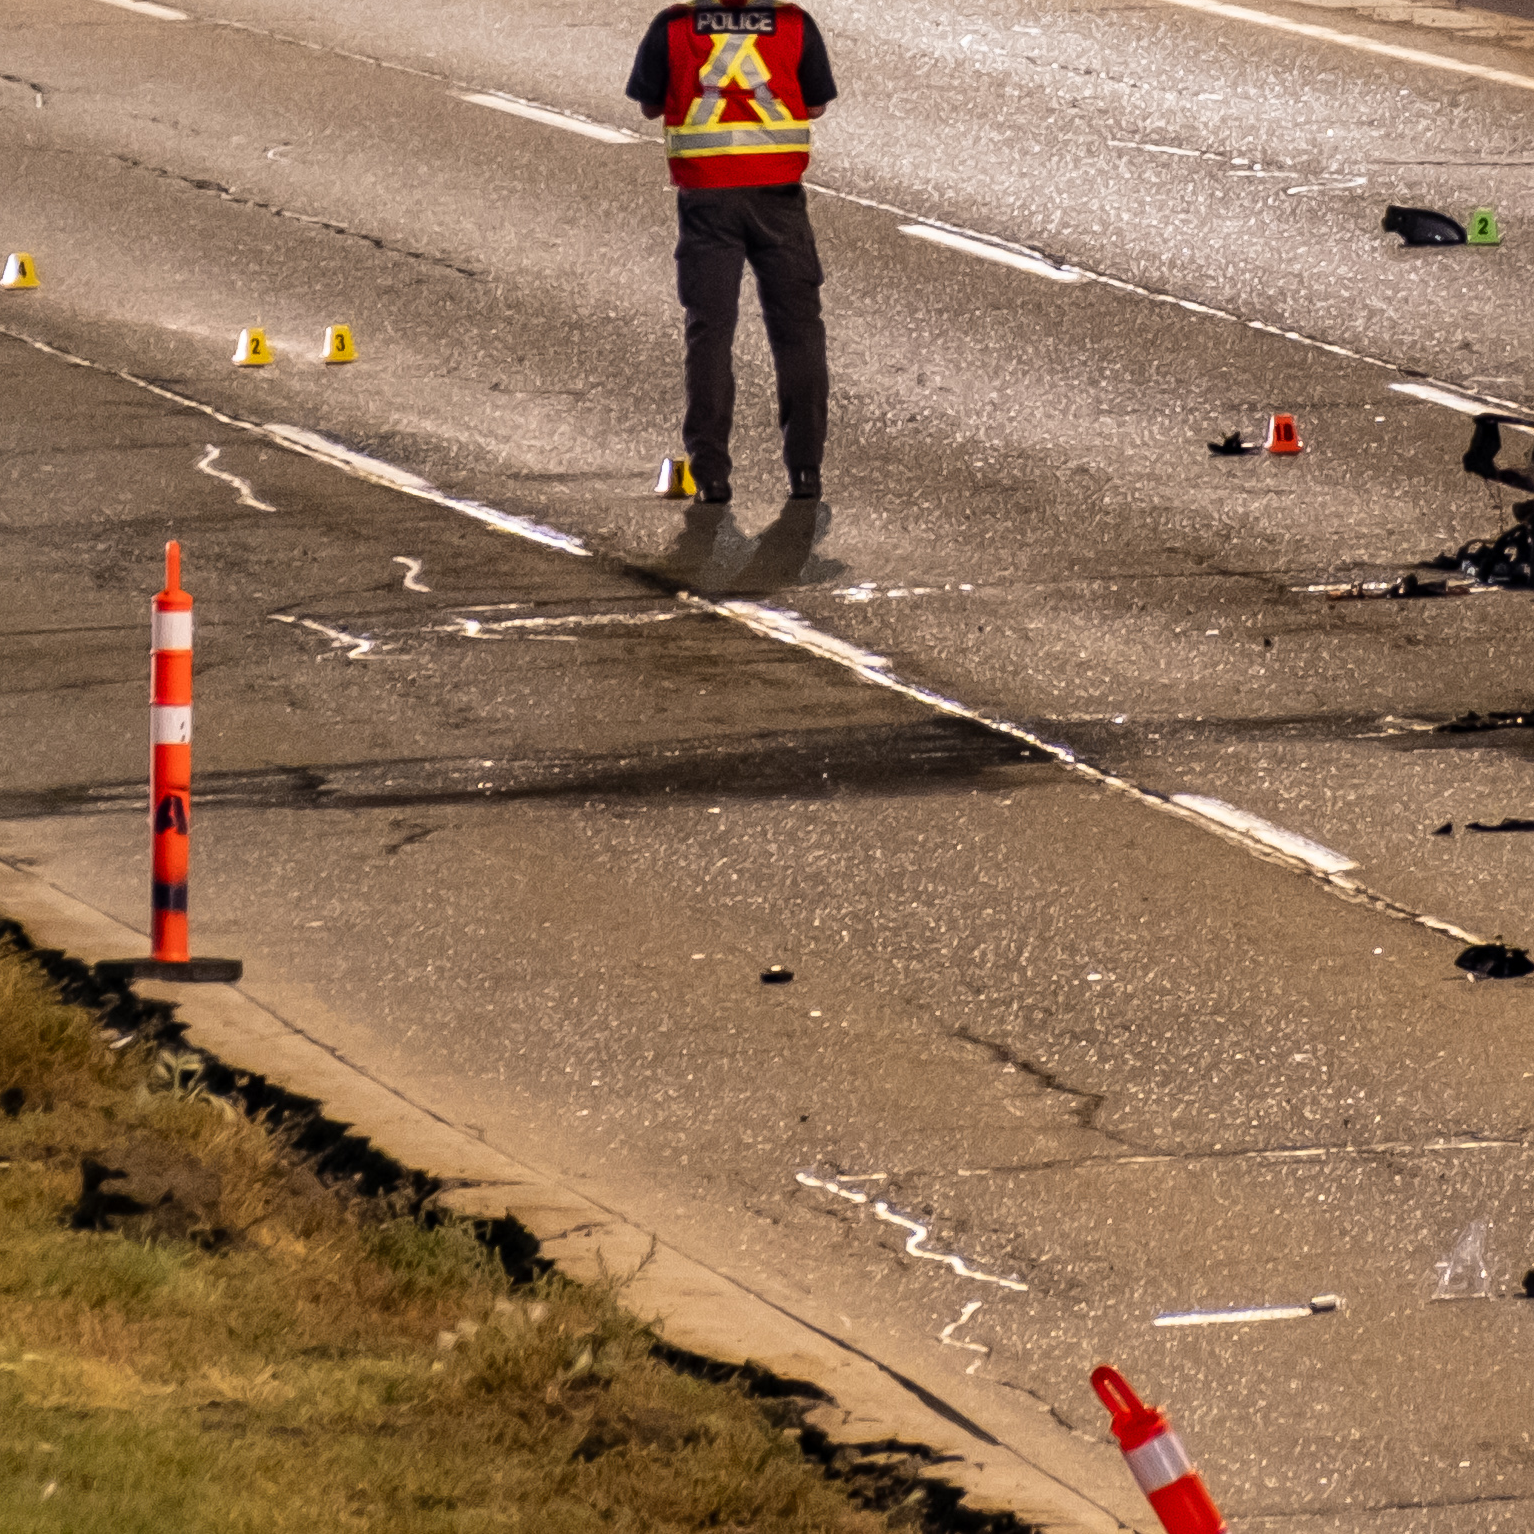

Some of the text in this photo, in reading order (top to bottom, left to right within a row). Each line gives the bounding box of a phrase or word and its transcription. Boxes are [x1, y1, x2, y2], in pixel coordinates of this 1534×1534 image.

[697, 12, 773, 31] POLICE
[1477, 217, 1489, 235] 2
[251, 337, 261, 356] 2
[335, 333, 346, 352] 3
